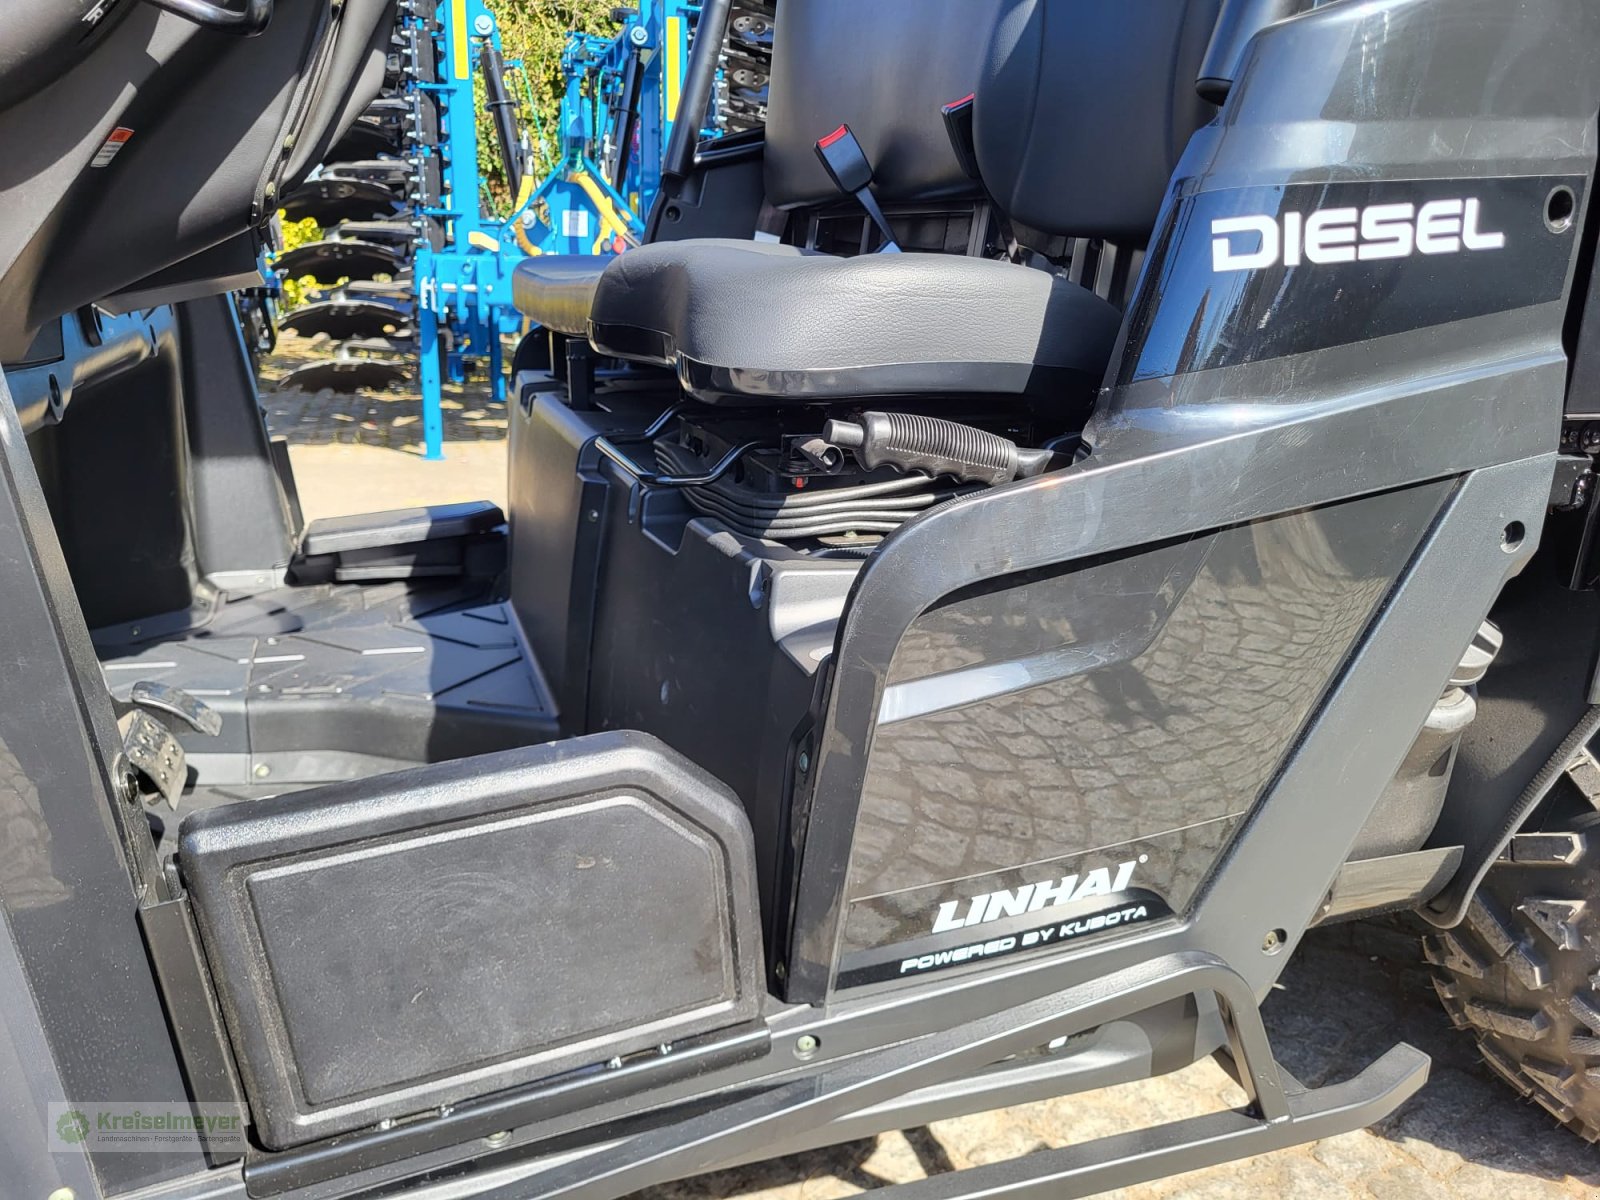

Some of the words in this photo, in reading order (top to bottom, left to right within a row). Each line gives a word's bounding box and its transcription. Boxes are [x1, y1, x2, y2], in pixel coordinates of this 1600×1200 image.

[1211, 197, 1504, 272] DIESEL
[932, 861, 1136, 933] LINHAI
[900, 937, 1016, 973] POWERED
[1022, 928, 1056, 946] BY
[1060, 906, 1147, 937] KUBOTA
